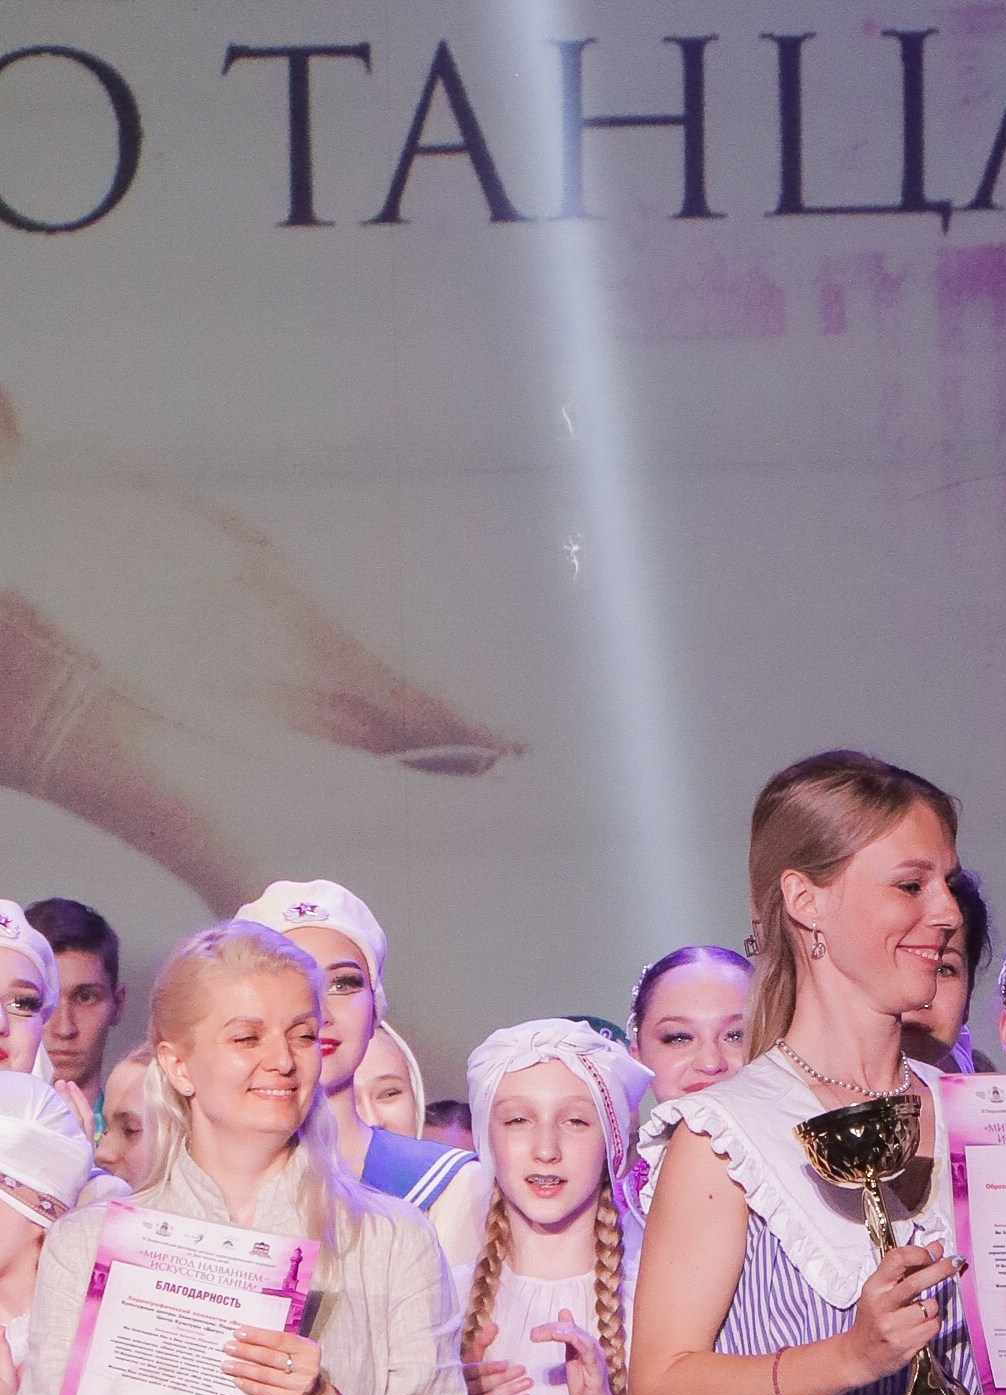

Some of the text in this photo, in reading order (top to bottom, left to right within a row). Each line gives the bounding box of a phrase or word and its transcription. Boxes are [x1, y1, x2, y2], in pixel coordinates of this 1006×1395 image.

[150, 1260, 216, 1282] ИСКУССТВО
[170, 1255, 196, 1269] ПОД
[197, 1261, 263, 1283] НАЗВАНИЕМ
[155, 1280, 242, 1309] БЛАГОДАРНОСТЬ
